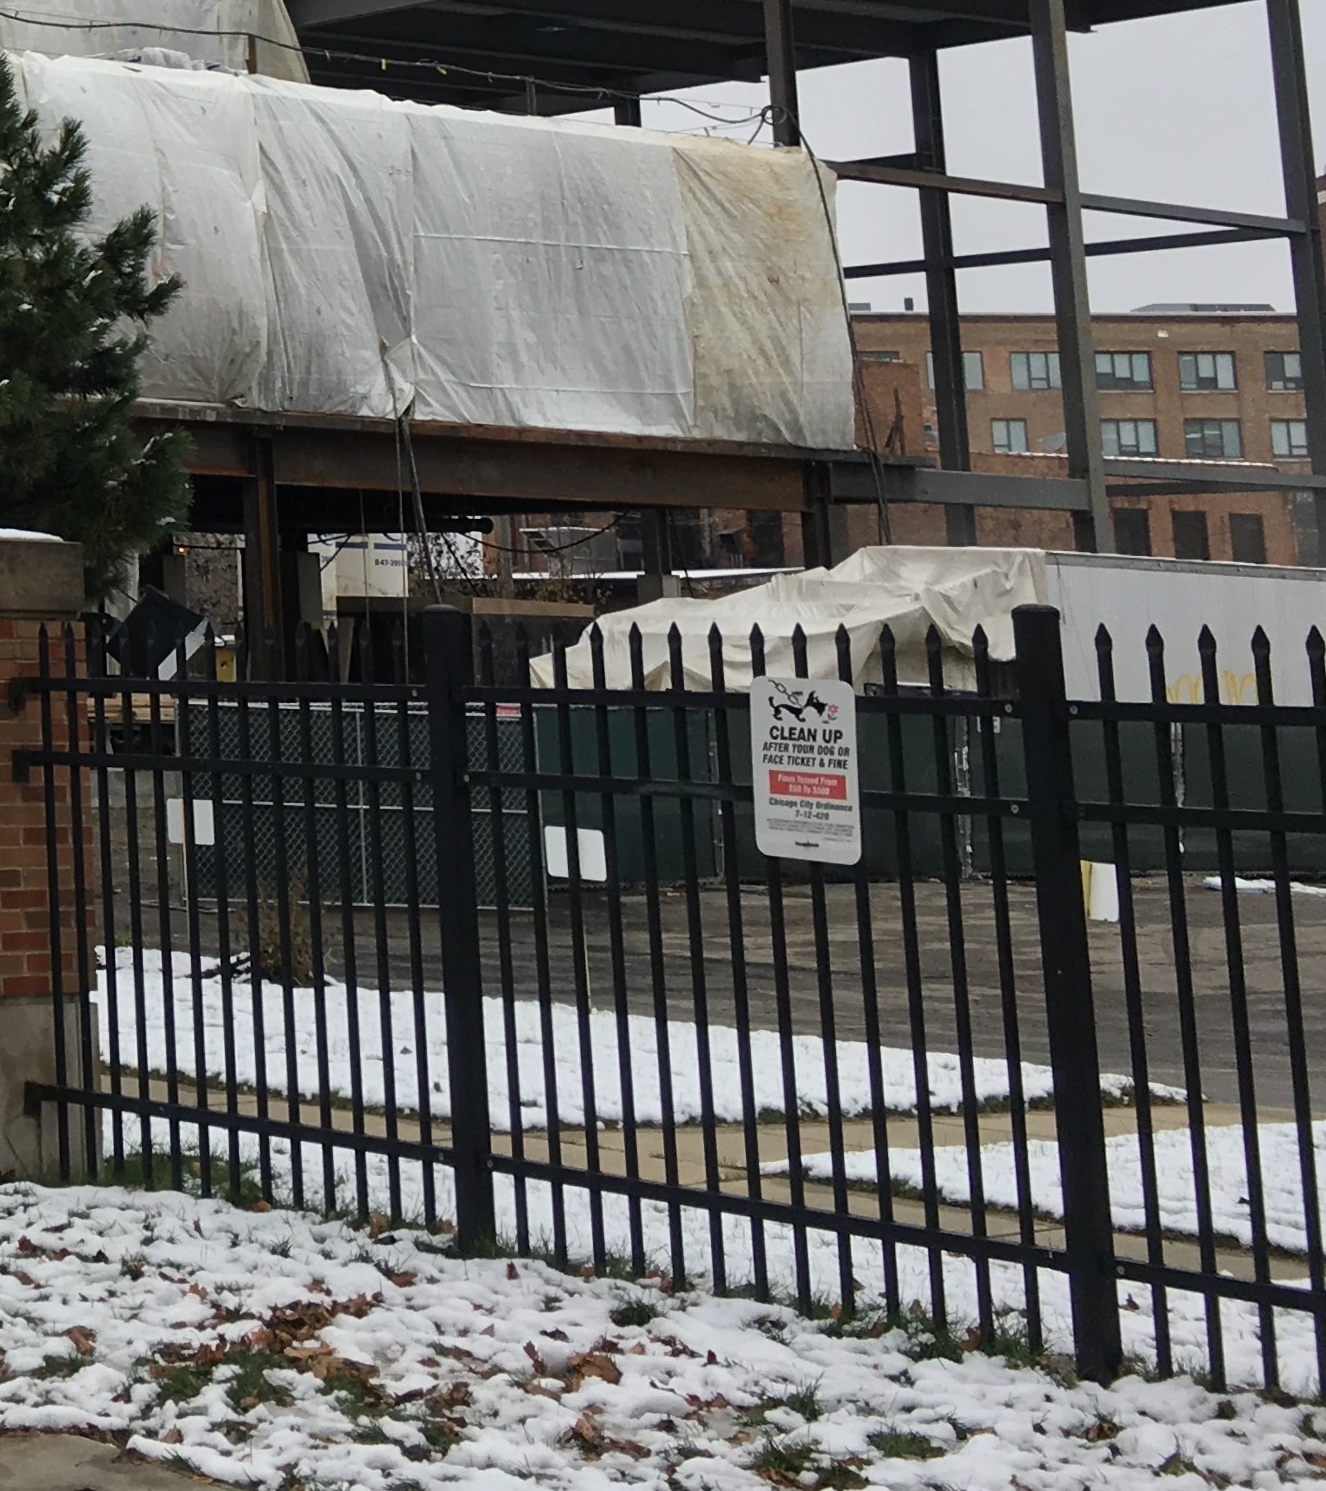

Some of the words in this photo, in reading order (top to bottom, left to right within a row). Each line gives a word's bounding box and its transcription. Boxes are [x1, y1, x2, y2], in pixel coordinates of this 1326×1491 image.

[769, 725, 818, 743] CLEAN
[822, 728, 843, 744] UP
[762, 741, 790, 753] AFTER
[792, 743, 815, 755] YOUR
[817, 744, 836, 757] DOG
[837, 746, 850, 758] OR
[762, 753, 785, 765] FACE
[787, 755, 817, 768] TICKET
[819, 757, 826, 769] &
[827, 758, 849, 770] FINE
[769, 796, 798, 809] Chicago
[799, 799, 815, 810] City
[815, 800, 854, 813] Ordinance
